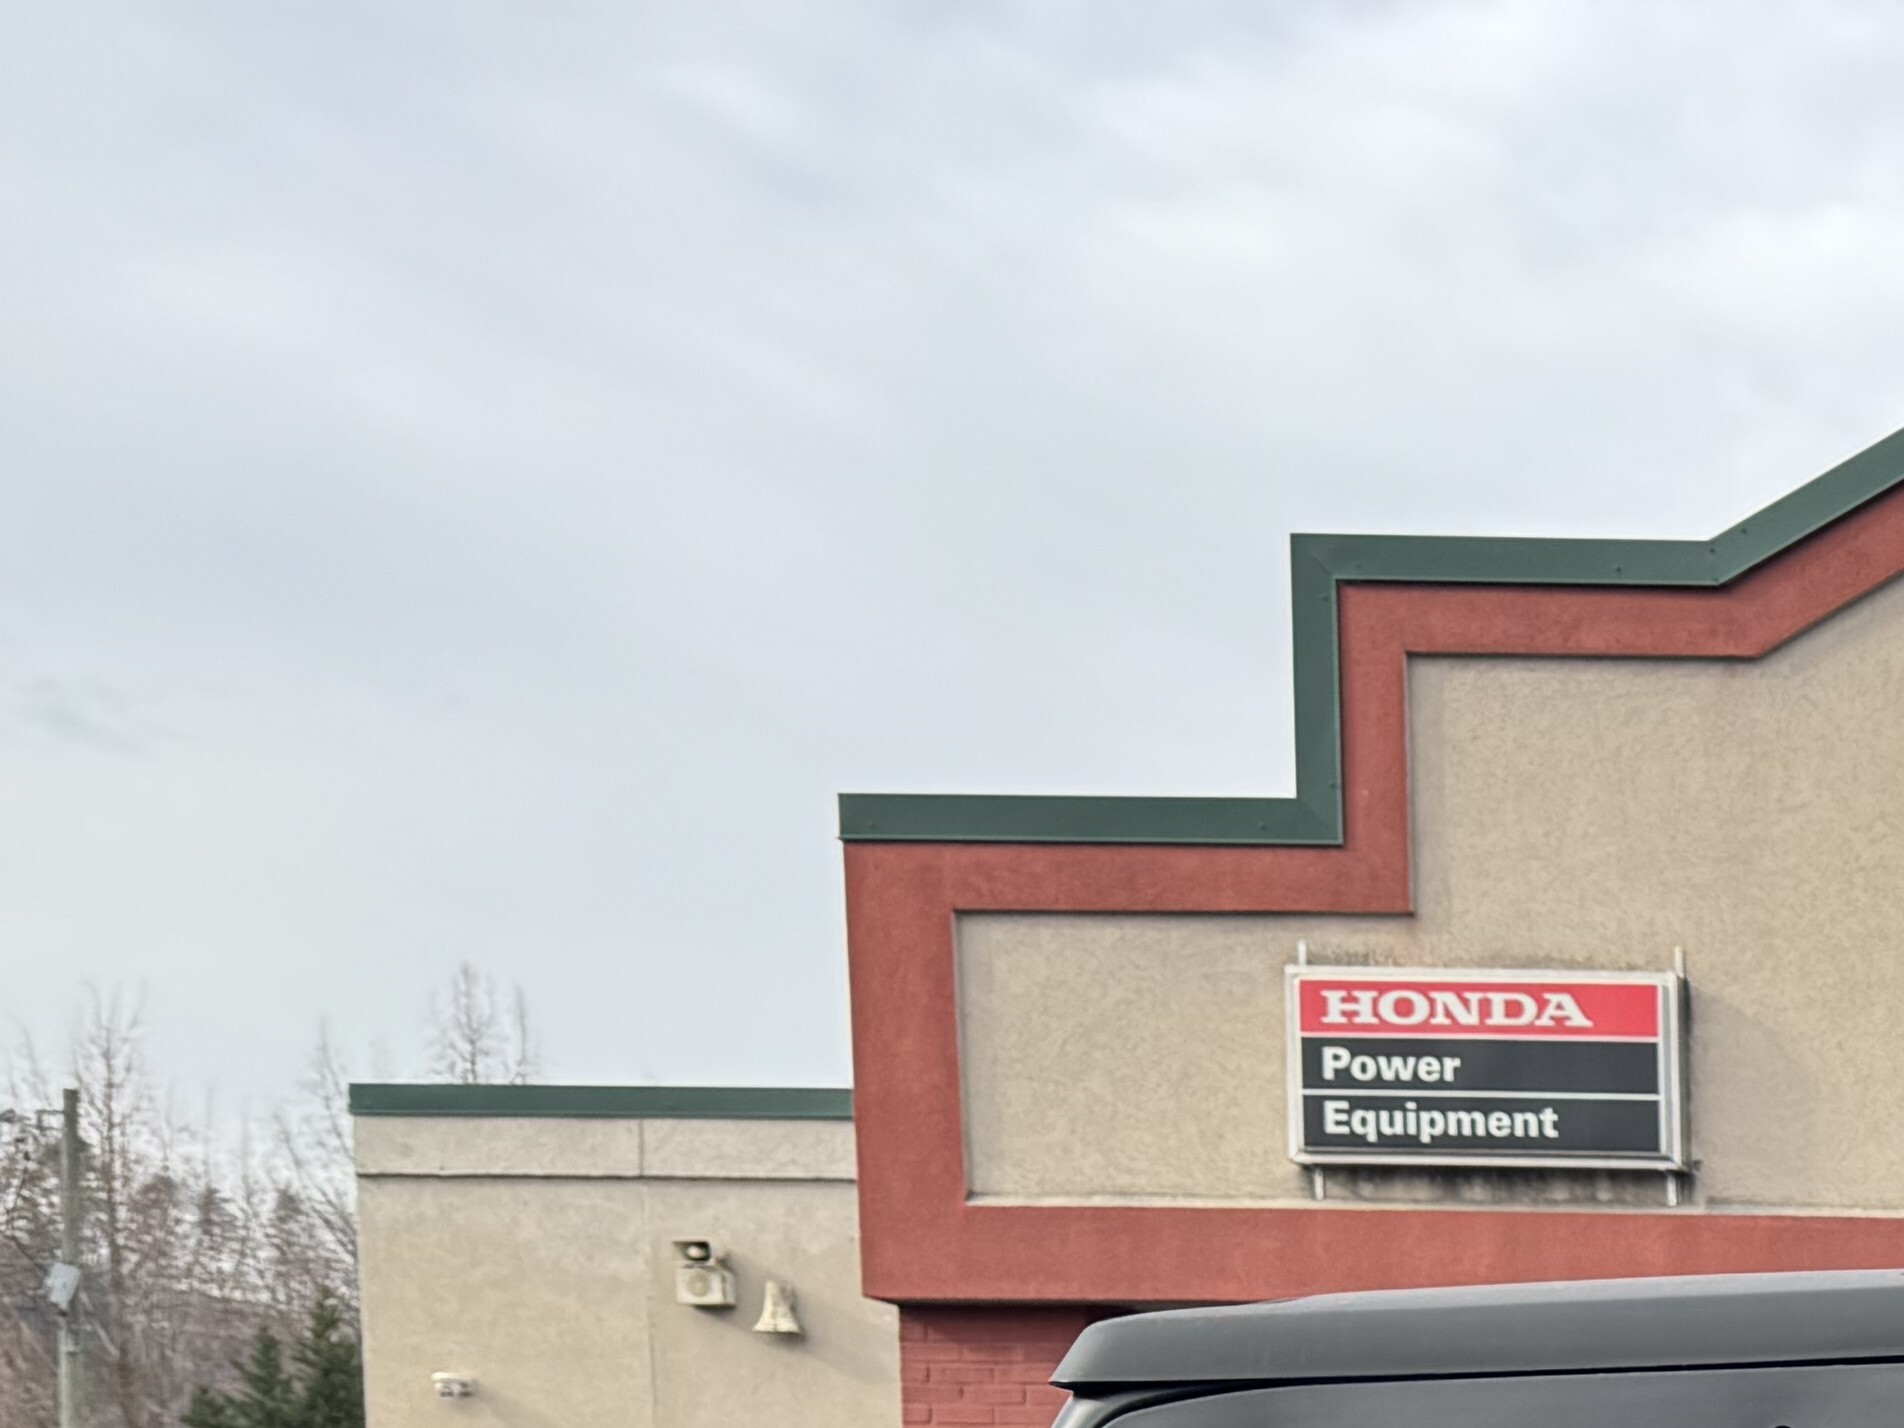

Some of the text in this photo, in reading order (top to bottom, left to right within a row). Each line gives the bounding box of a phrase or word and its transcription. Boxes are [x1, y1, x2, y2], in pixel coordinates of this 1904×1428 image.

[1320, 989, 1594, 1028] HONDA
[1321, 1046, 1461, 1083] Power
[1322, 1100, 1559, 1143] Equipment
